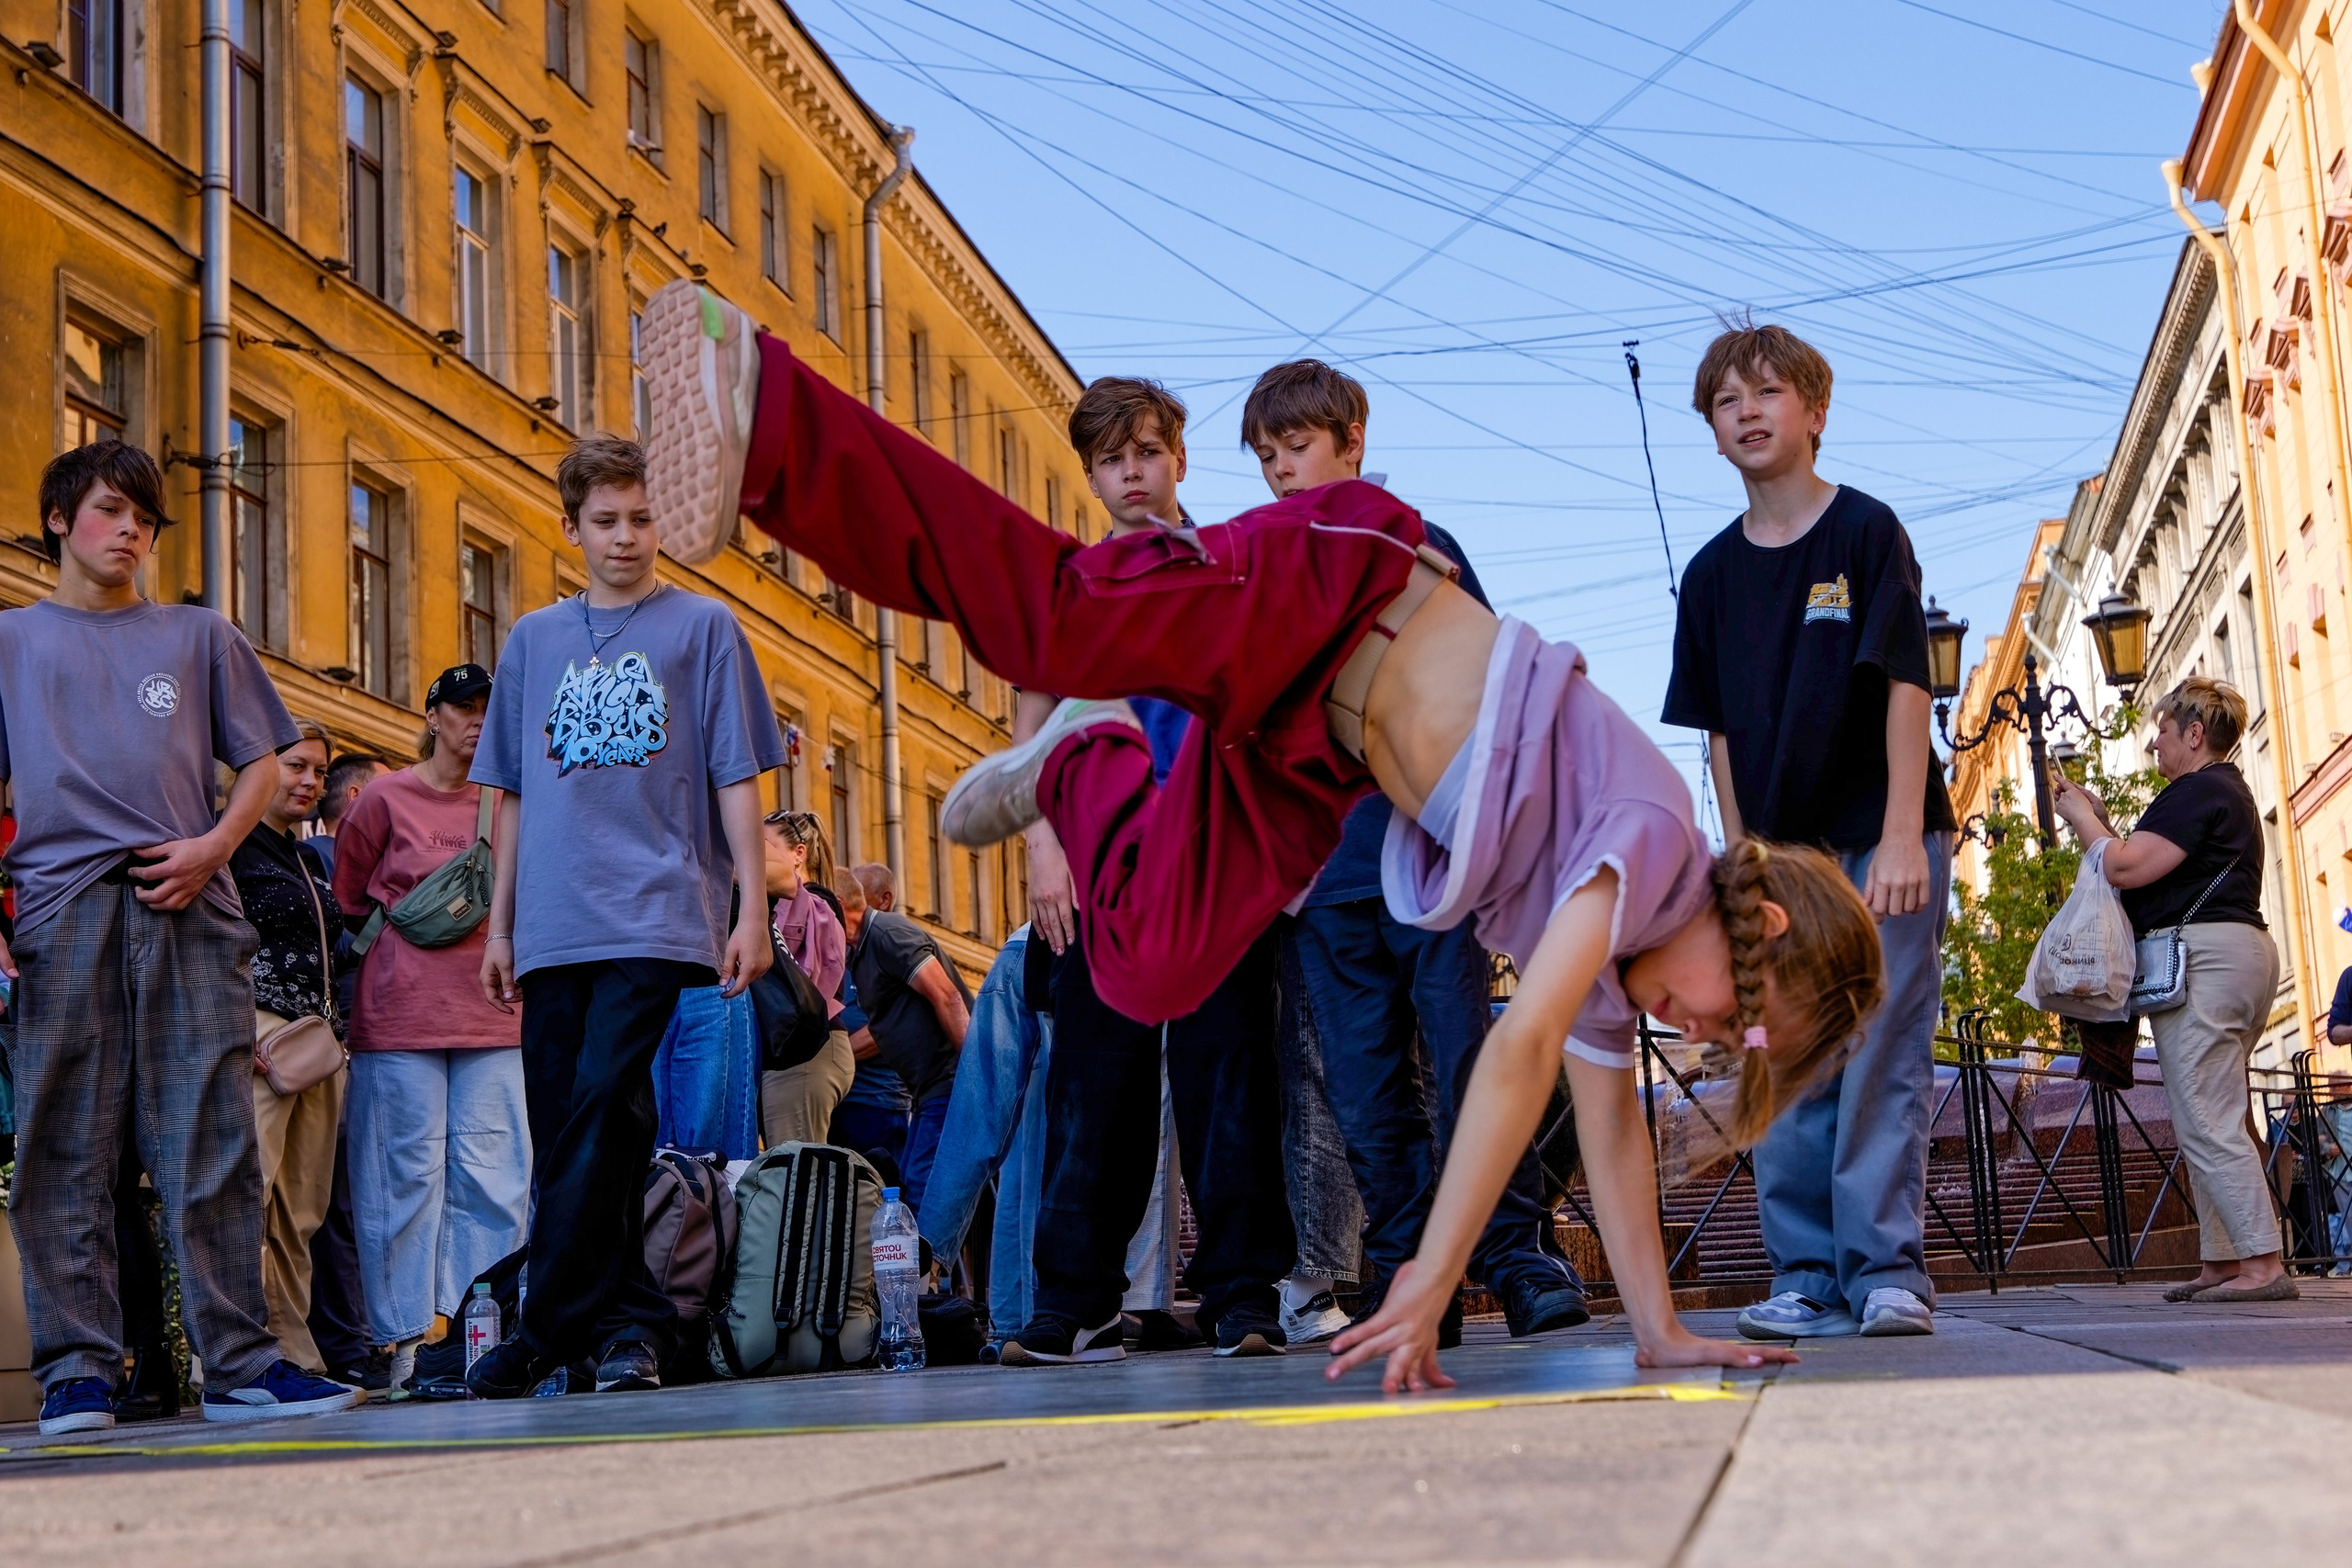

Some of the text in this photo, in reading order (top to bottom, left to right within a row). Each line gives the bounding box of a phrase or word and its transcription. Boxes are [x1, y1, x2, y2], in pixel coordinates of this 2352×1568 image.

[1805, 607, 1850, 620] GRANDFINAL
[454, 670, 468, 682] 75
[429, 836, 468, 850] TIME
[872, 1243, 901, 1255] СВЯТОЙ
[872, 1252, 908, 1263] СТОЧНИК
